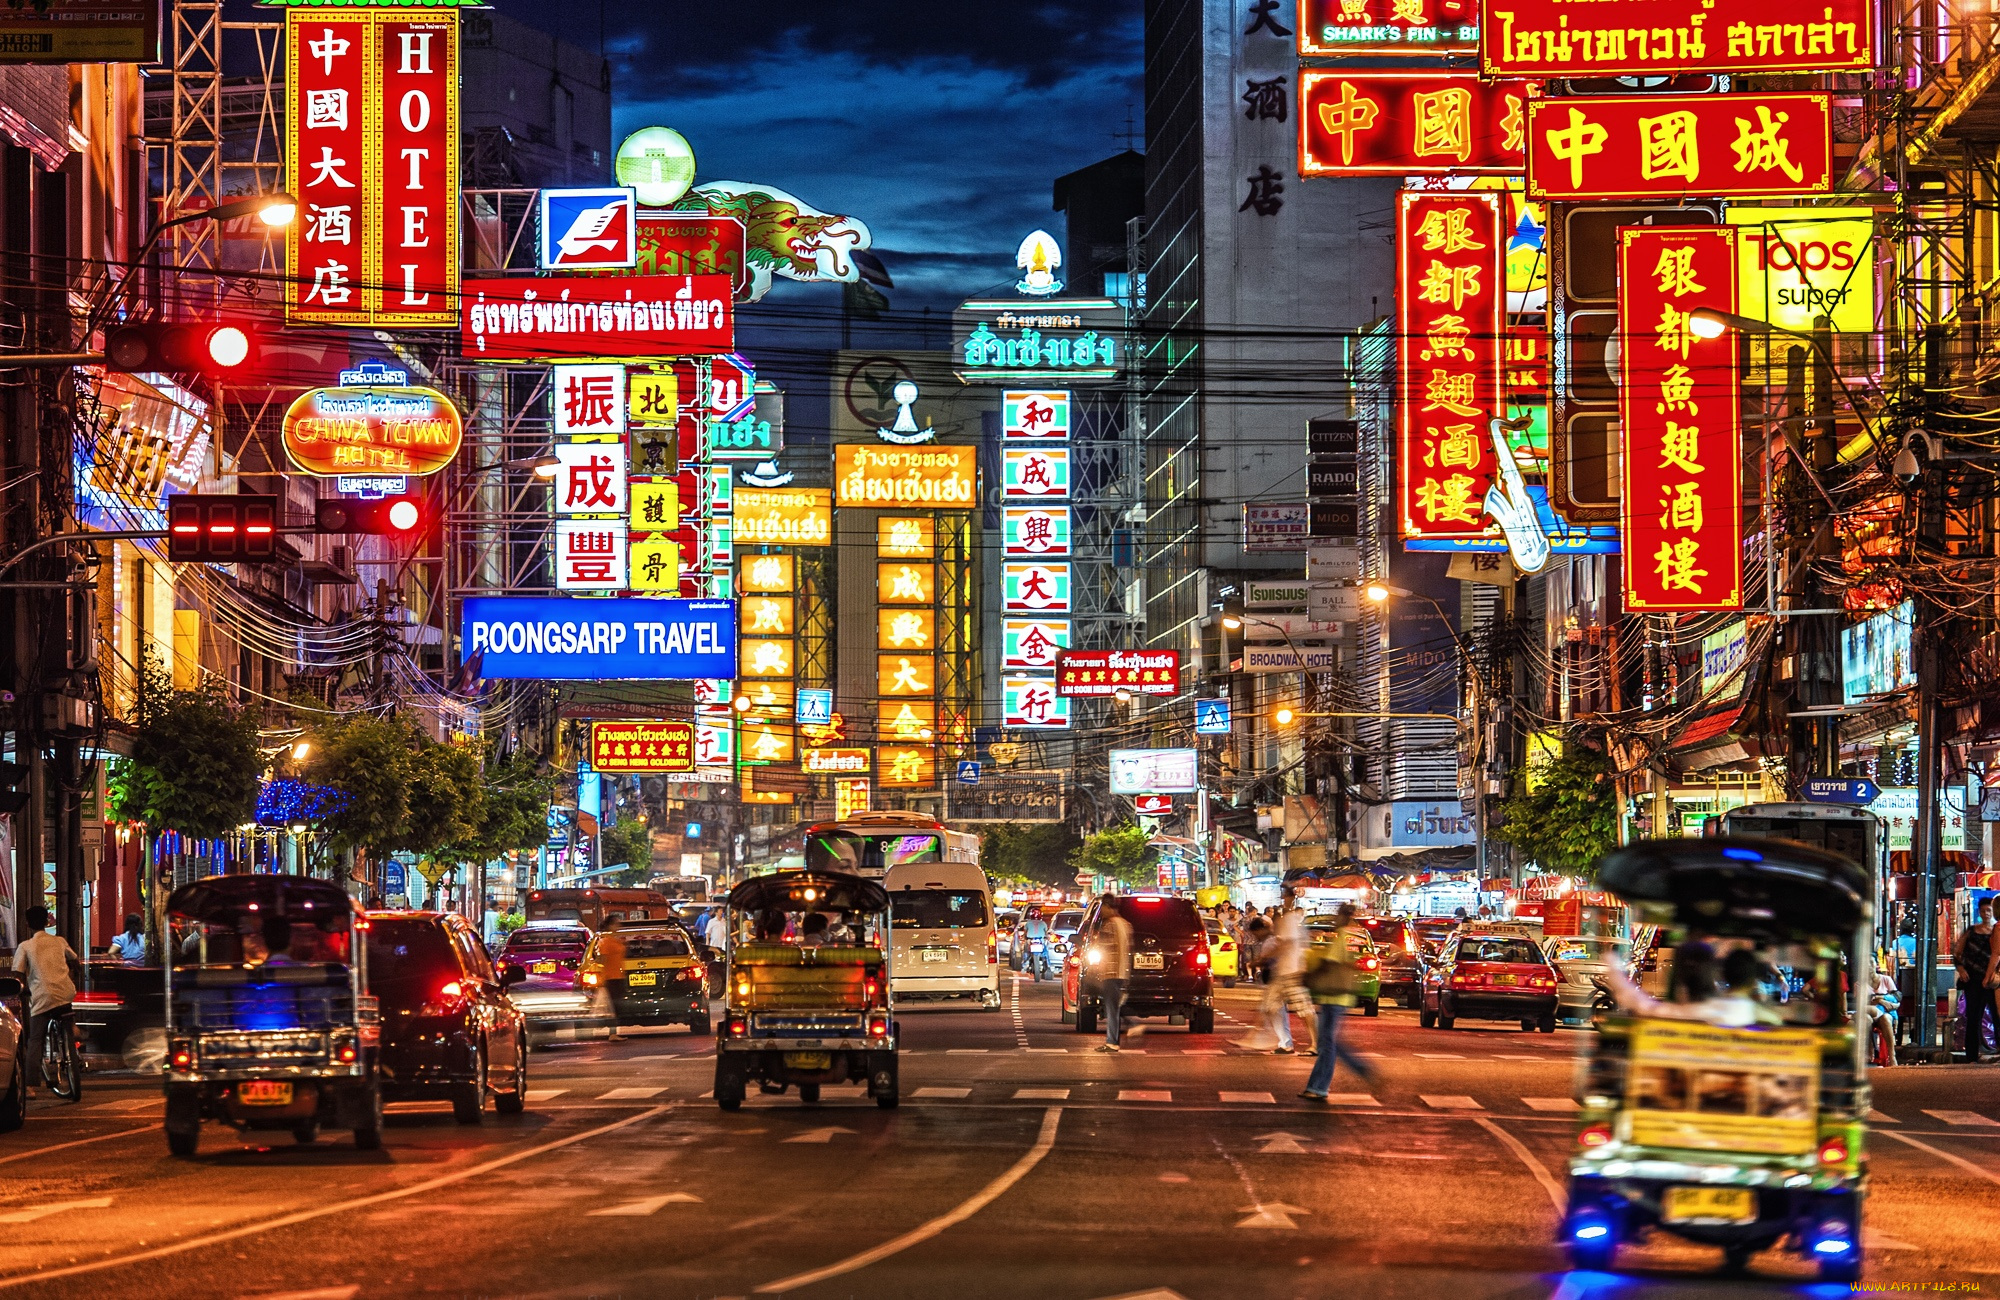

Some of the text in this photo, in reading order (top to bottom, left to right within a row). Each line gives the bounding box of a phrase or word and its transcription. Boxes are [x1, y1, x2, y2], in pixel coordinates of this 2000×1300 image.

[1323, 25, 1401, 41] SHARK'S
[1407, 26, 1436, 41] FIN
[1495, 7, 1858, 63] ไชน่าทาวน์ สกาล่า
[1238, 0, 1293, 217] 大酒店
[1546, 105, 1803, 190] 中國城
[305, 28, 357, 306] 中國大酒店
[397, 32, 435, 306] HOTEL
[1745, 234, 1854, 285] Tops
[1777, 288, 1853, 313] super
[1414, 207, 1487, 526] 銀都魚翅酒樓
[295, 418, 452, 445] CHINA TOWN
[1651, 245, 1709, 595] 銀都魚翅酒樓
[1311, 431, 1354, 442] CITIZEN
[334, 446, 411, 469] HOTEL
[565, 375, 617, 583] 振成豐
[1312, 472, 1355, 483] RADO
[1317, 513, 1350, 523] MIDO
[1020, 401, 1053, 720] 和成興大金行
[1321, 597, 1347, 605] BALL
[472, 621, 726, 654] ROONGSARP TRAVEL
[1250, 653, 1304, 666] BROADWAY
[1406, 651, 1446, 666] MIDO
[1810, 781, 1867, 798] เยาวราช 2
